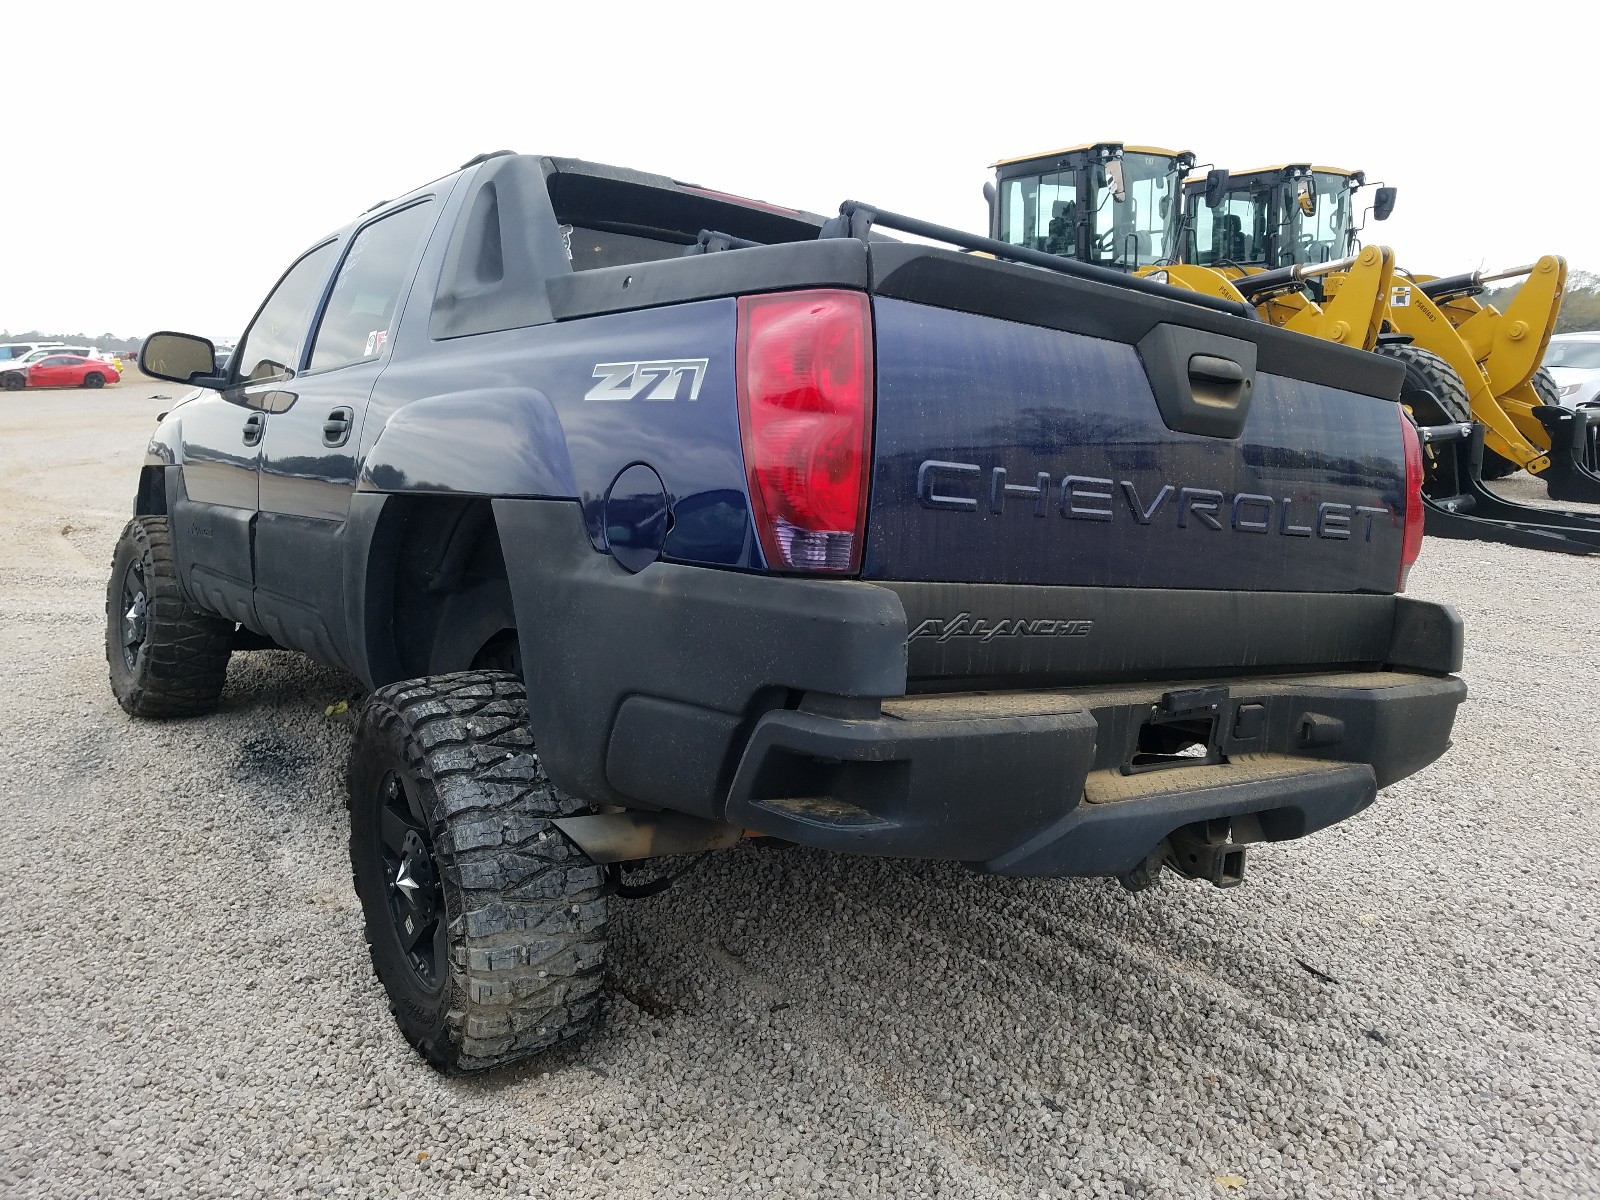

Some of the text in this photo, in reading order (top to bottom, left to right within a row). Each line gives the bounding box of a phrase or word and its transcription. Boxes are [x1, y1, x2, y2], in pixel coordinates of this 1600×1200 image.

[584, 357, 709, 401] Z71
[917, 459, 1389, 542] CHEVROLET
[907, 612, 1095, 643] AVALANCHE
